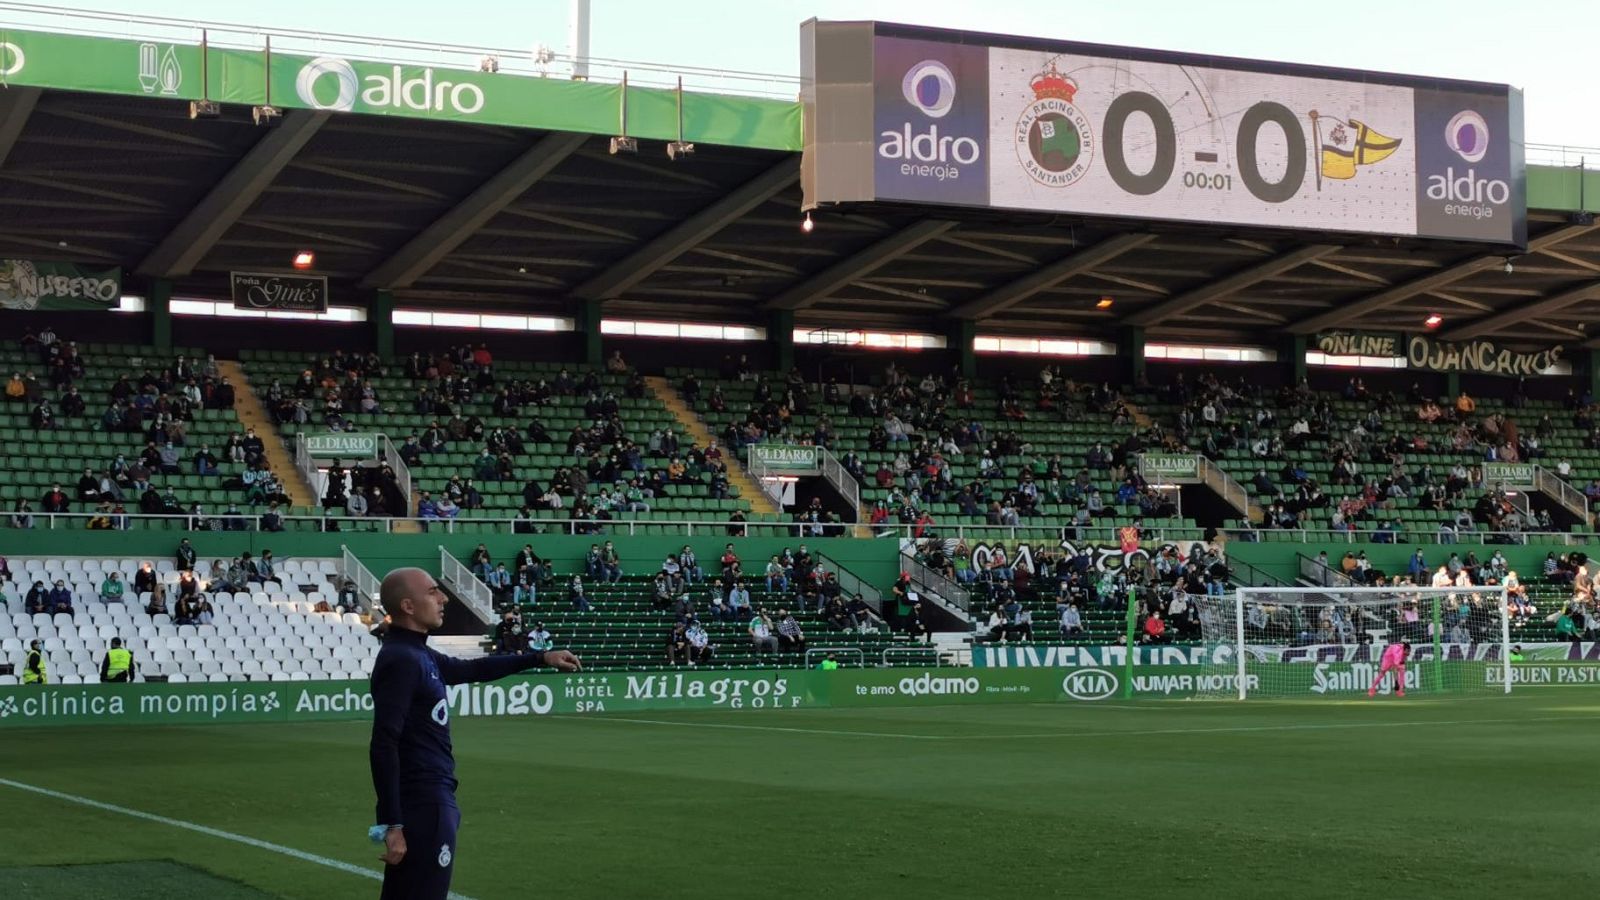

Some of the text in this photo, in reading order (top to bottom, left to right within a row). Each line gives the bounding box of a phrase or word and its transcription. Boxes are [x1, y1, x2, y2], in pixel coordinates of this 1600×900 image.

[362, 65, 485, 114] aldro
[1018, 101, 1091, 147] REAL RACING CLUB
[879, 122, 980, 164] aldro
[1102, 91, 1177, 195] 0
[1236, 101, 1306, 203] 0
[1026, 160, 1084, 184] SANTANDER
[1184, 172, 1232, 191] 00:01
[1427, 167, 1509, 204] aldro
[20, 275, 118, 301] NUBERO
[247, 278, 319, 308] Ginés
[1319, 335, 1395, 355] ONLINE
[307, 437, 374, 450] EL DIARIO
[757, 447, 814, 460] EL DIARIO
[1160, 458, 1196, 469] DIARIO
[1501, 466, 1532, 477] DIARIO
[856, 672, 980, 696] te amo adamo
[1072, 675, 1110, 693] KIA
[1131, 675, 1259, 692] NUMAR MOTOR
[1486, 666, 1600, 683] EL BUEN PAST
[565, 686, 614, 697] HOTEL
[624, 674, 787, 704] Milagros
[23, 688, 257, 718] clínica mompía
[576, 701, 605, 712] SPA
[731, 696, 802, 708] GOLF
